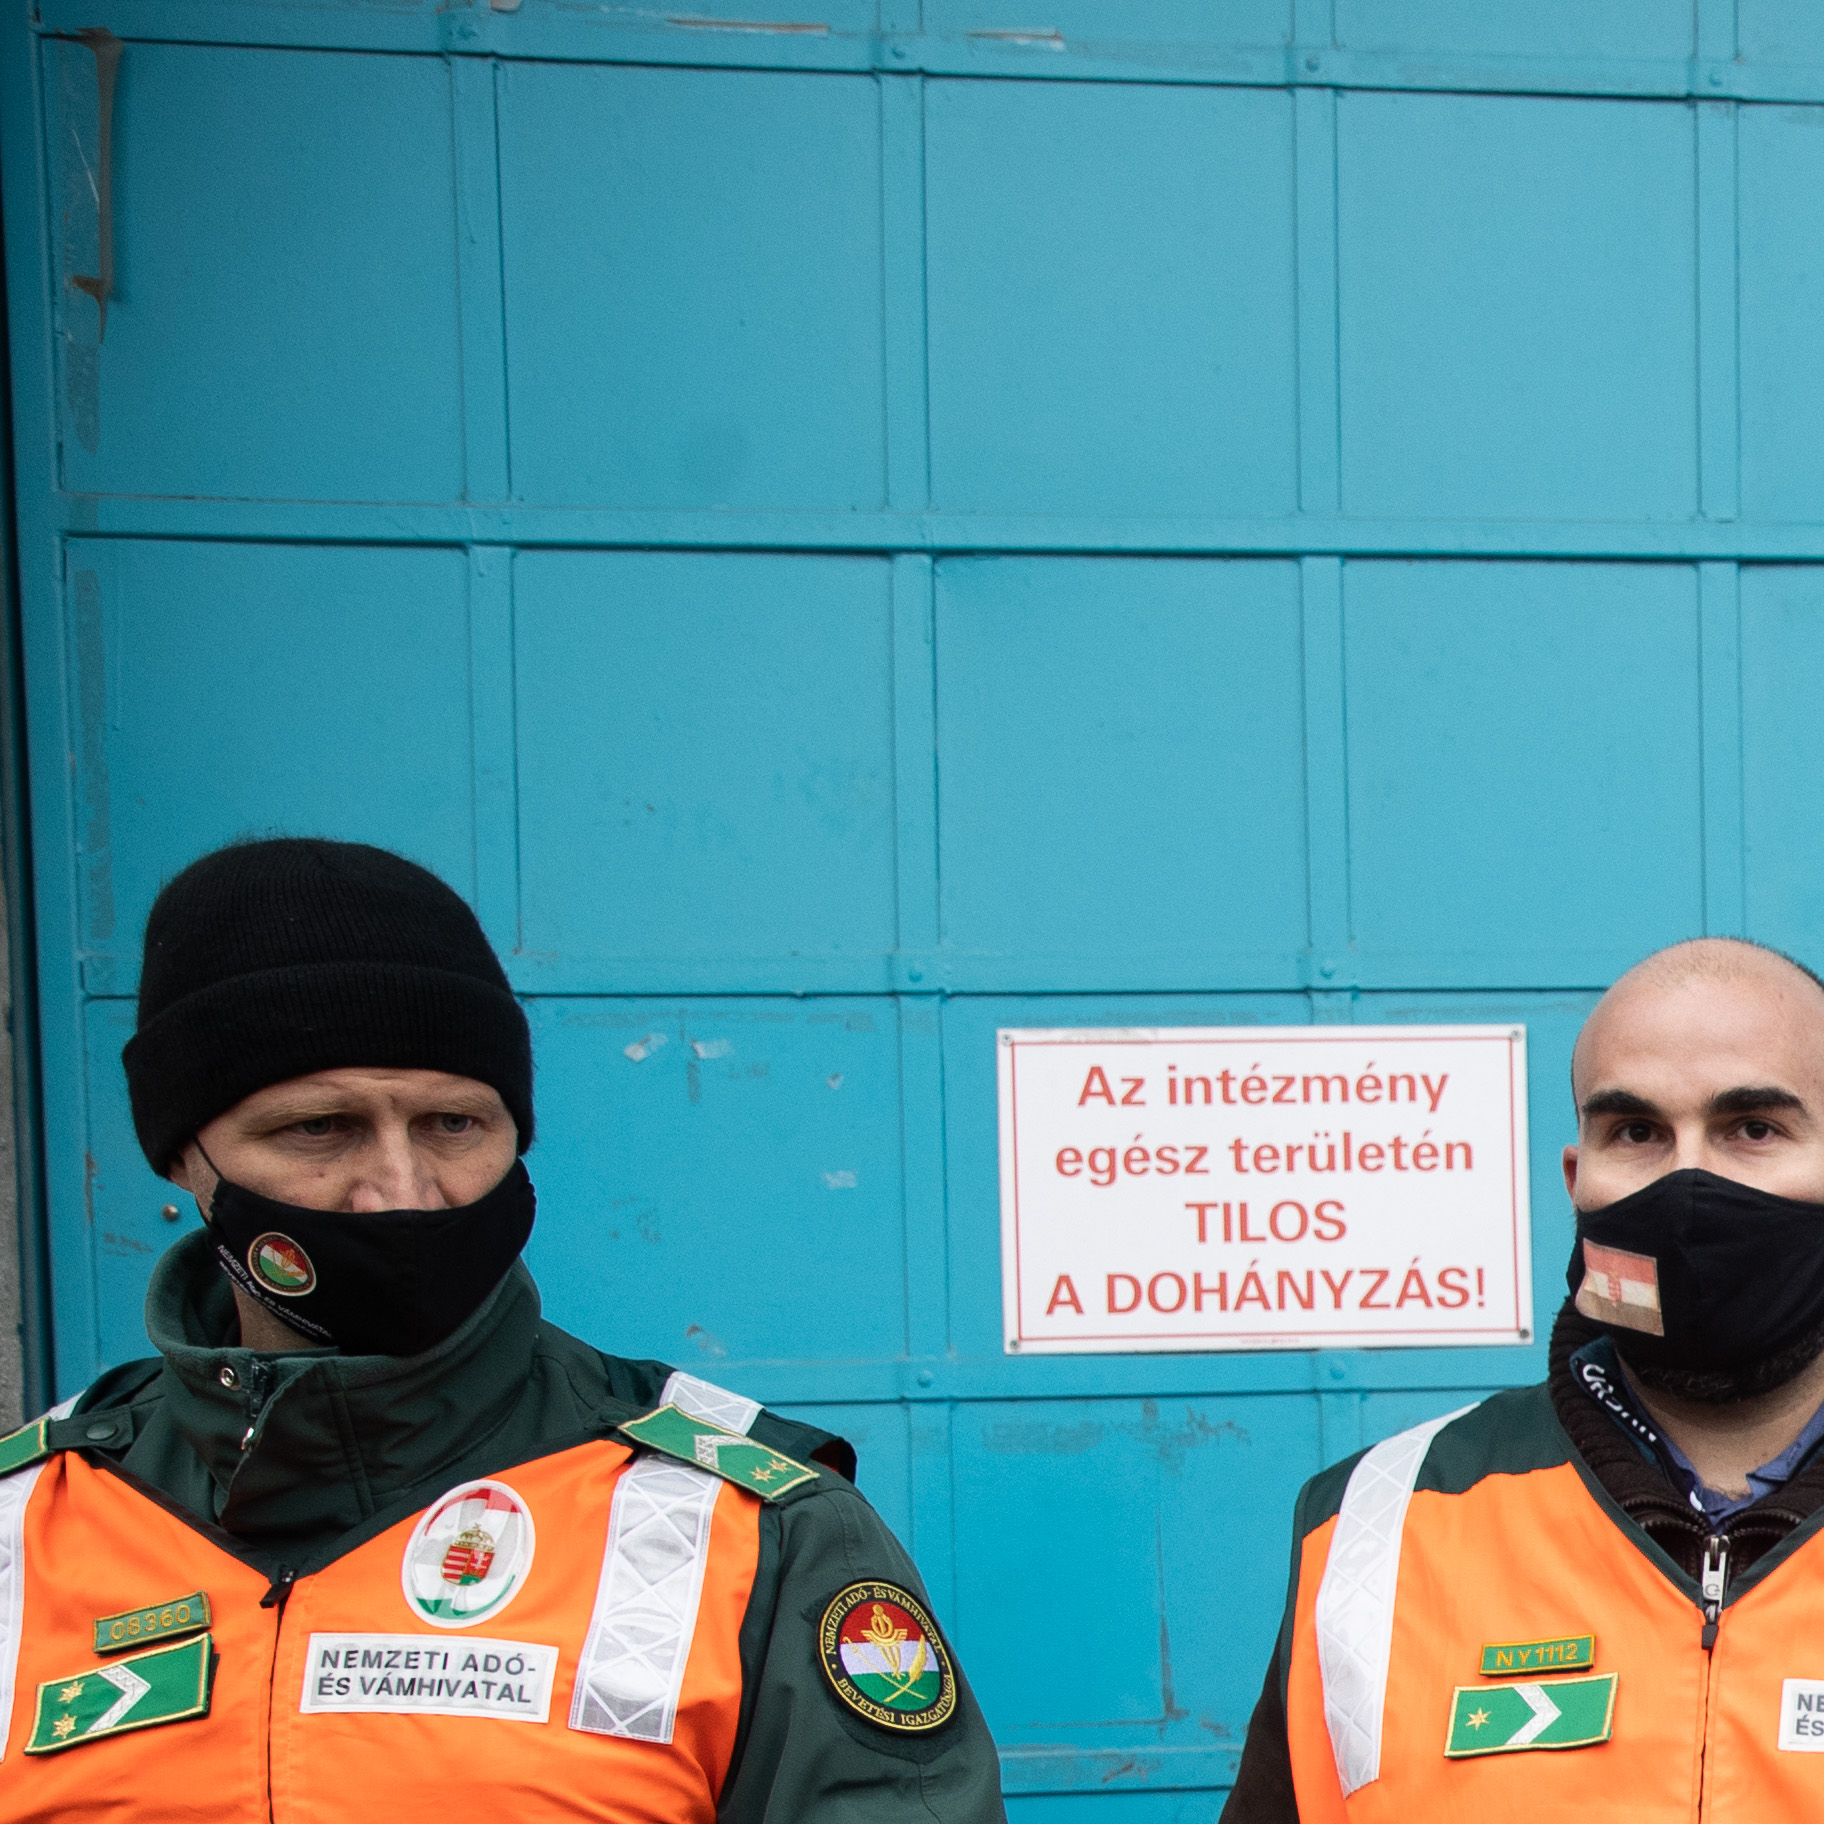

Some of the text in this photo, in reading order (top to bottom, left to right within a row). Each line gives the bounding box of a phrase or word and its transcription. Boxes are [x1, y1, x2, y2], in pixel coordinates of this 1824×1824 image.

[1077, 1061, 1449, 1113] Az intézmény
[1055, 1130, 1474, 1187] egész területén
[1184, 1200, 1348, 1244] TILOS
[1045, 1257, 1487, 1316] A DOHÁNYZÁS!
[110, 1604, 191, 1641] 08360
[825, 1602, 849, 1655] NEMZETI
[873, 1586, 887, 1598] ÉS
[321, 1649, 537, 1676] NEMZETI ADÓ-
[317, 1673, 533, 1704] ÉS VÁMHIVATAL
[838, 1677, 896, 1723] BEVETÉSI
[1795, 1714, 1824, 1737] ÉS
